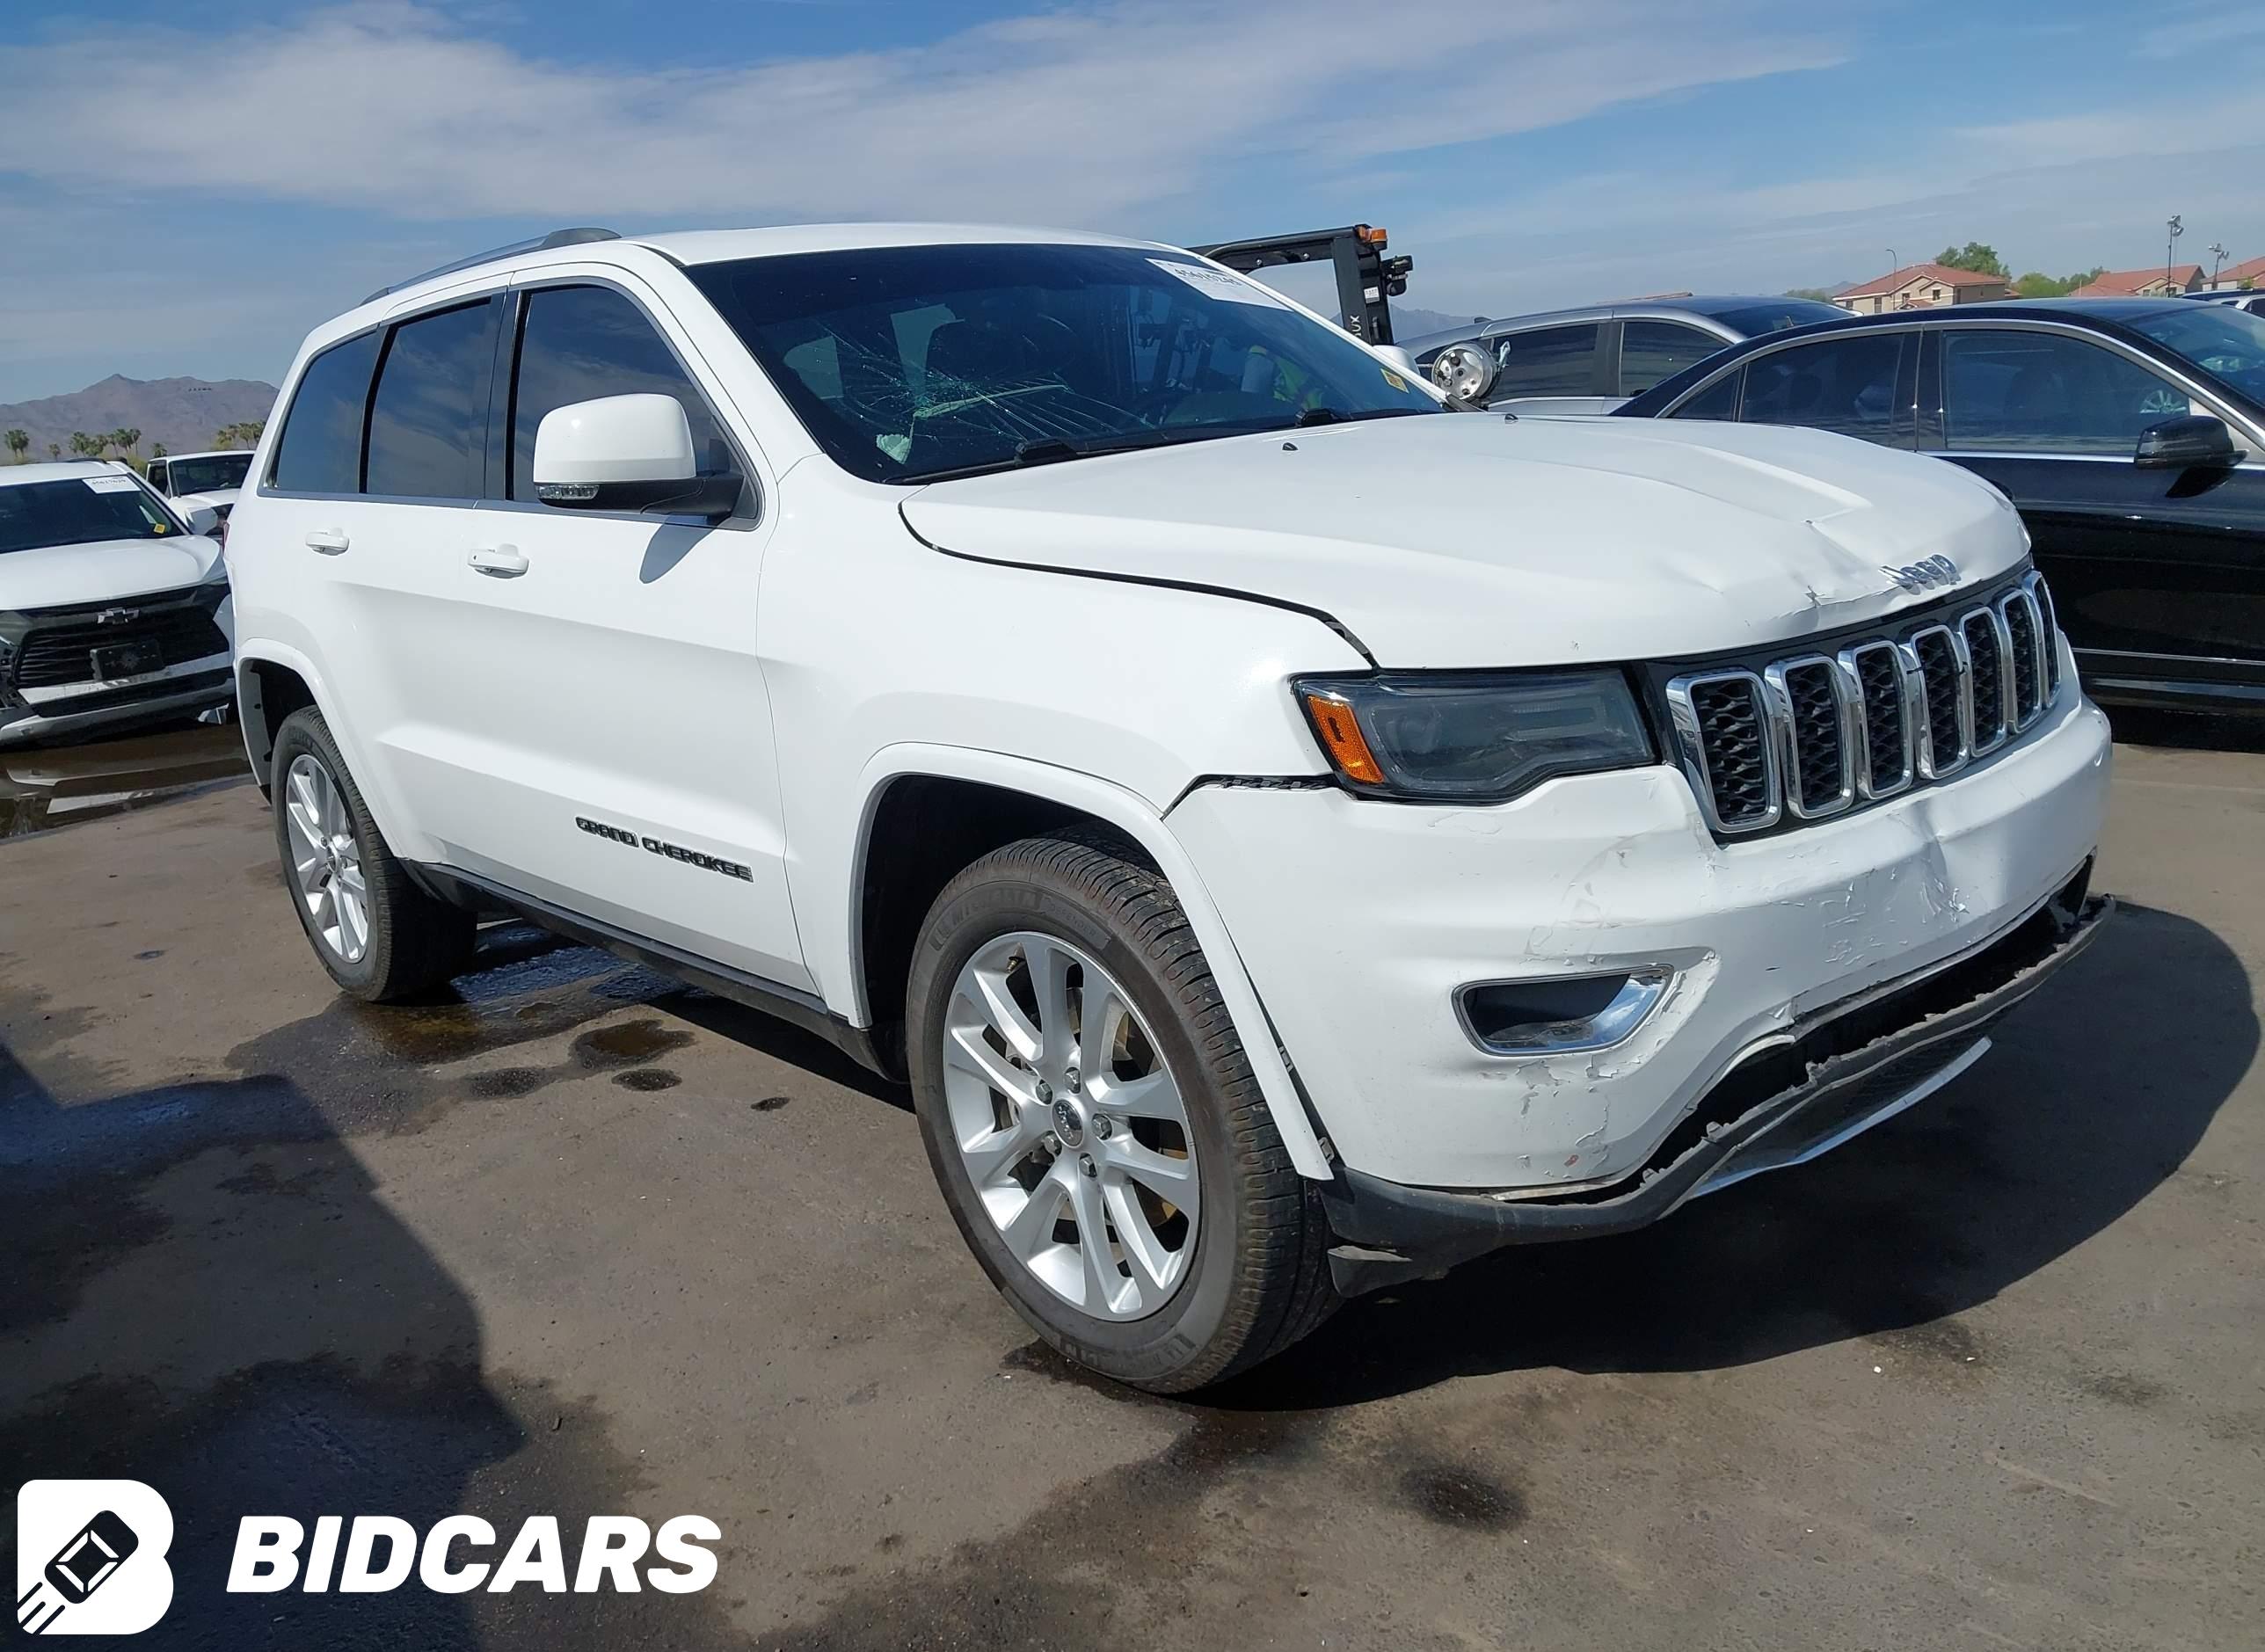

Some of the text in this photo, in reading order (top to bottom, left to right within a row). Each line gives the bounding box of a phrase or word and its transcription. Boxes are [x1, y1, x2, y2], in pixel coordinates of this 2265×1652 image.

[1878, 554, 1962, 588] Jeep
[575, 816, 754, 883] GRAND CHEROKEE
